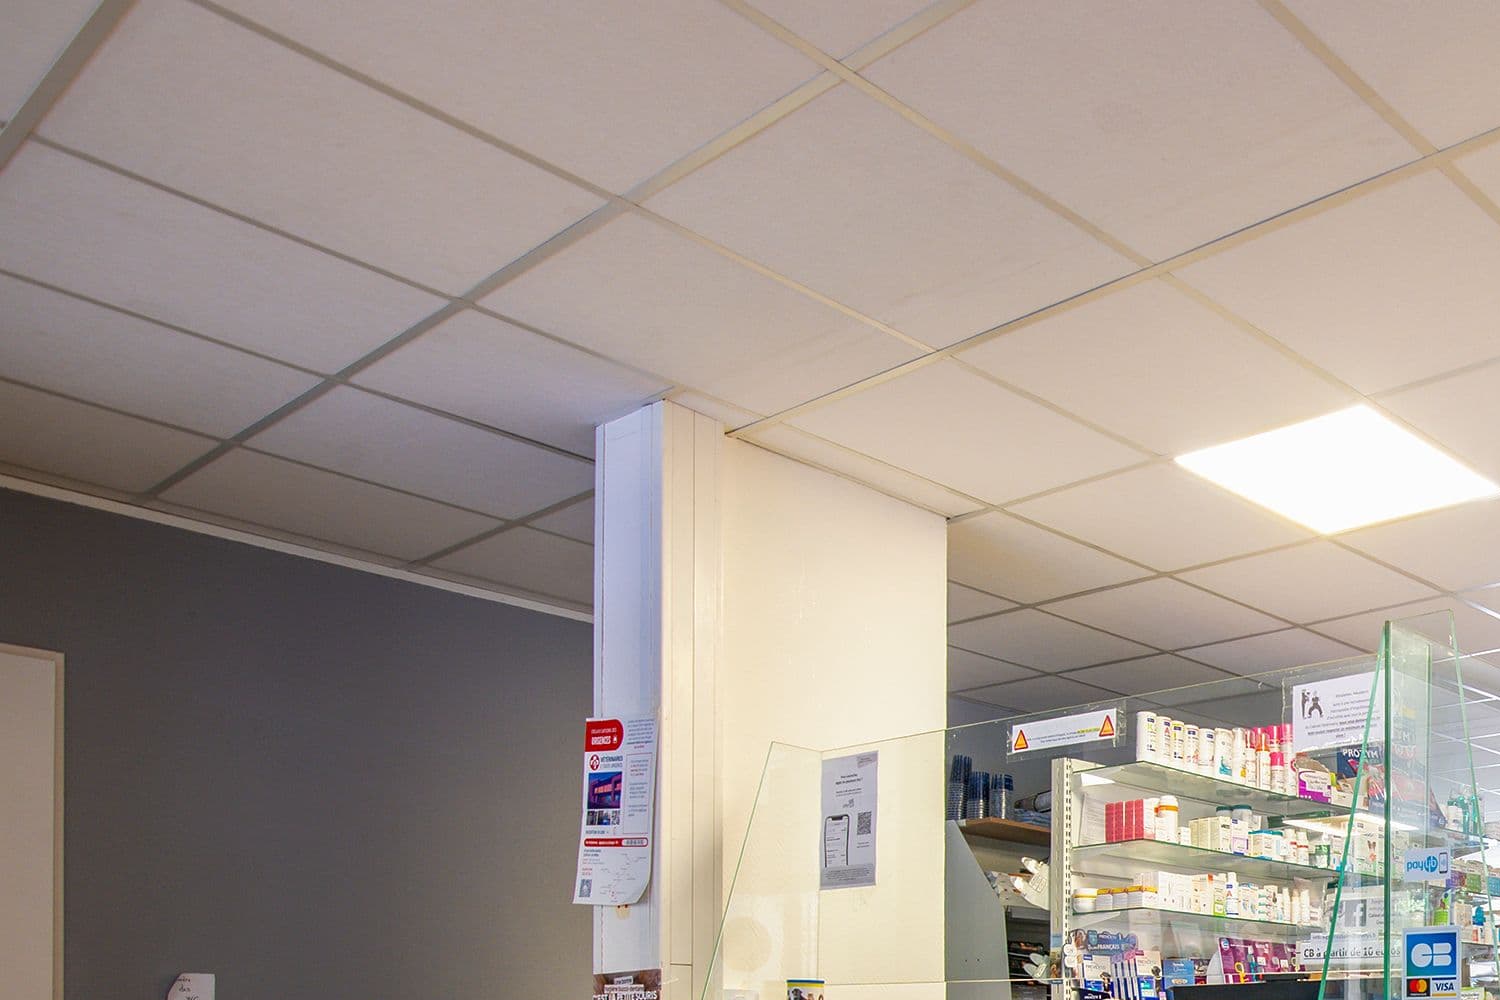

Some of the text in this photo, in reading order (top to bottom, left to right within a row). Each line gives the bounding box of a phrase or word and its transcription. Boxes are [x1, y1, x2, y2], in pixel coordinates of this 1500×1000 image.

[1342, 749, 1379, 759] PROYM
[1303, 948, 1315, 958] CB
[1316, 948, 1322, 957] à
[1435, 982, 1454, 991] VISA
[617, 991, 633, 1000] PETITE
[634, 990, 658, 1000] SOURIS
